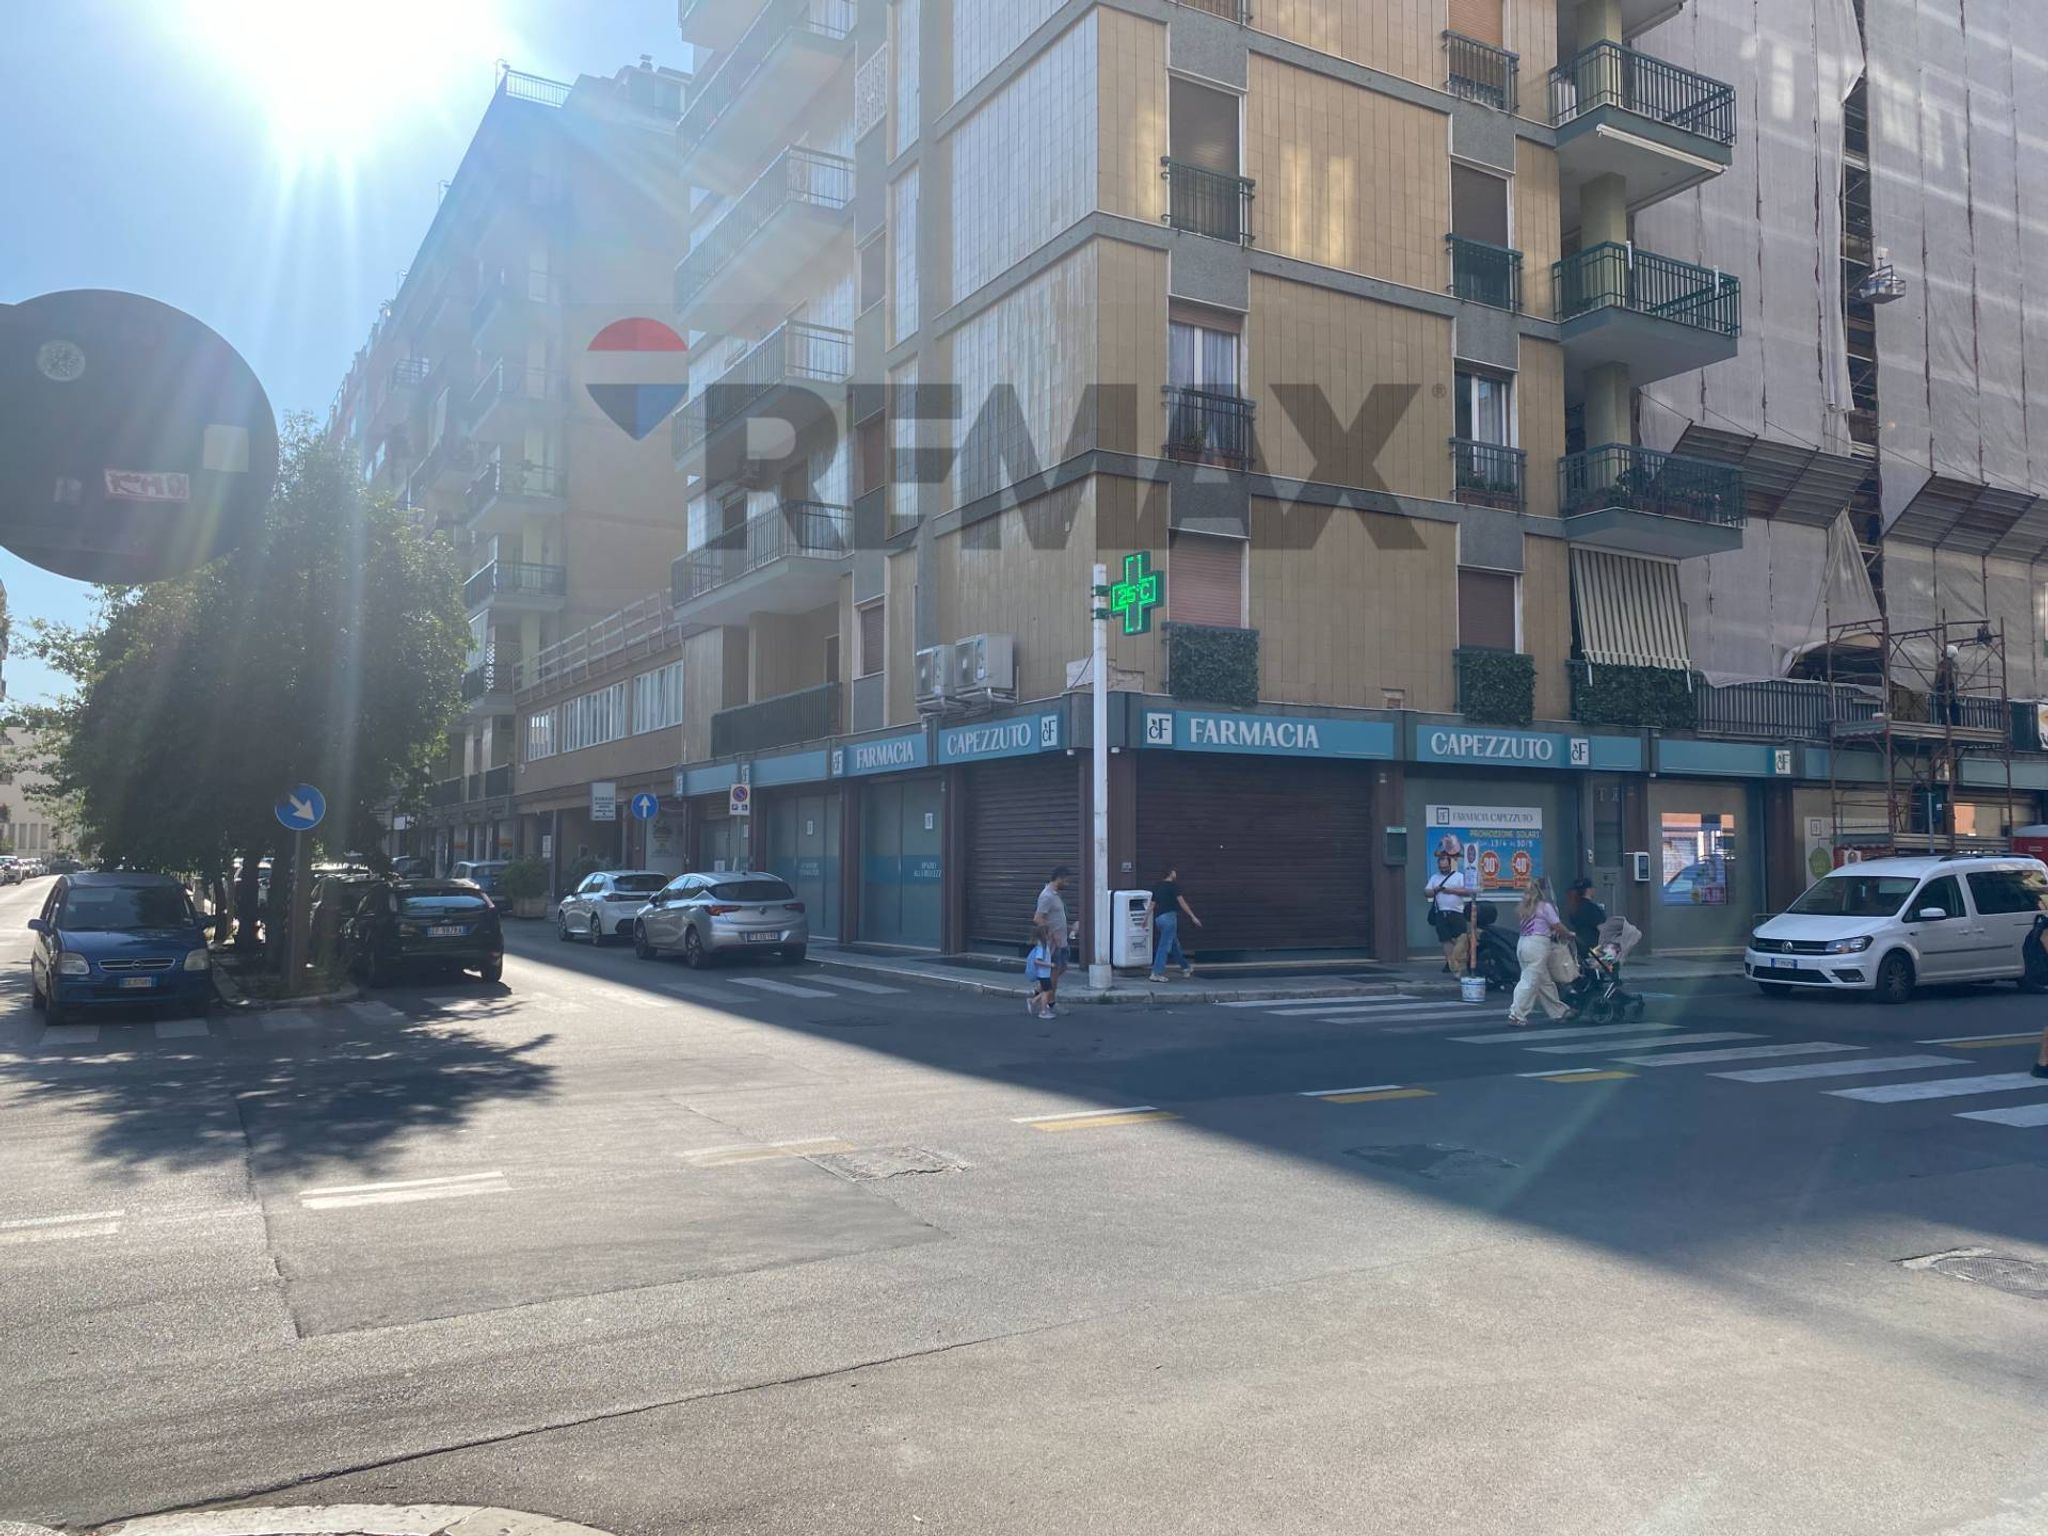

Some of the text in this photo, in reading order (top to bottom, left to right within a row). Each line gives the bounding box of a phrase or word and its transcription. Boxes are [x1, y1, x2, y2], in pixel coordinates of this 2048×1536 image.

[856, 740, 914, 770] FARMACIA
[947, 723, 1032, 756] CAPEZZUTO
[1190, 718, 1320, 749] FARMACIA
[1431, 732, 1553, 761] CAPEZZUTO
[1490, 812, 1533, 823] CAPEZZUTO
